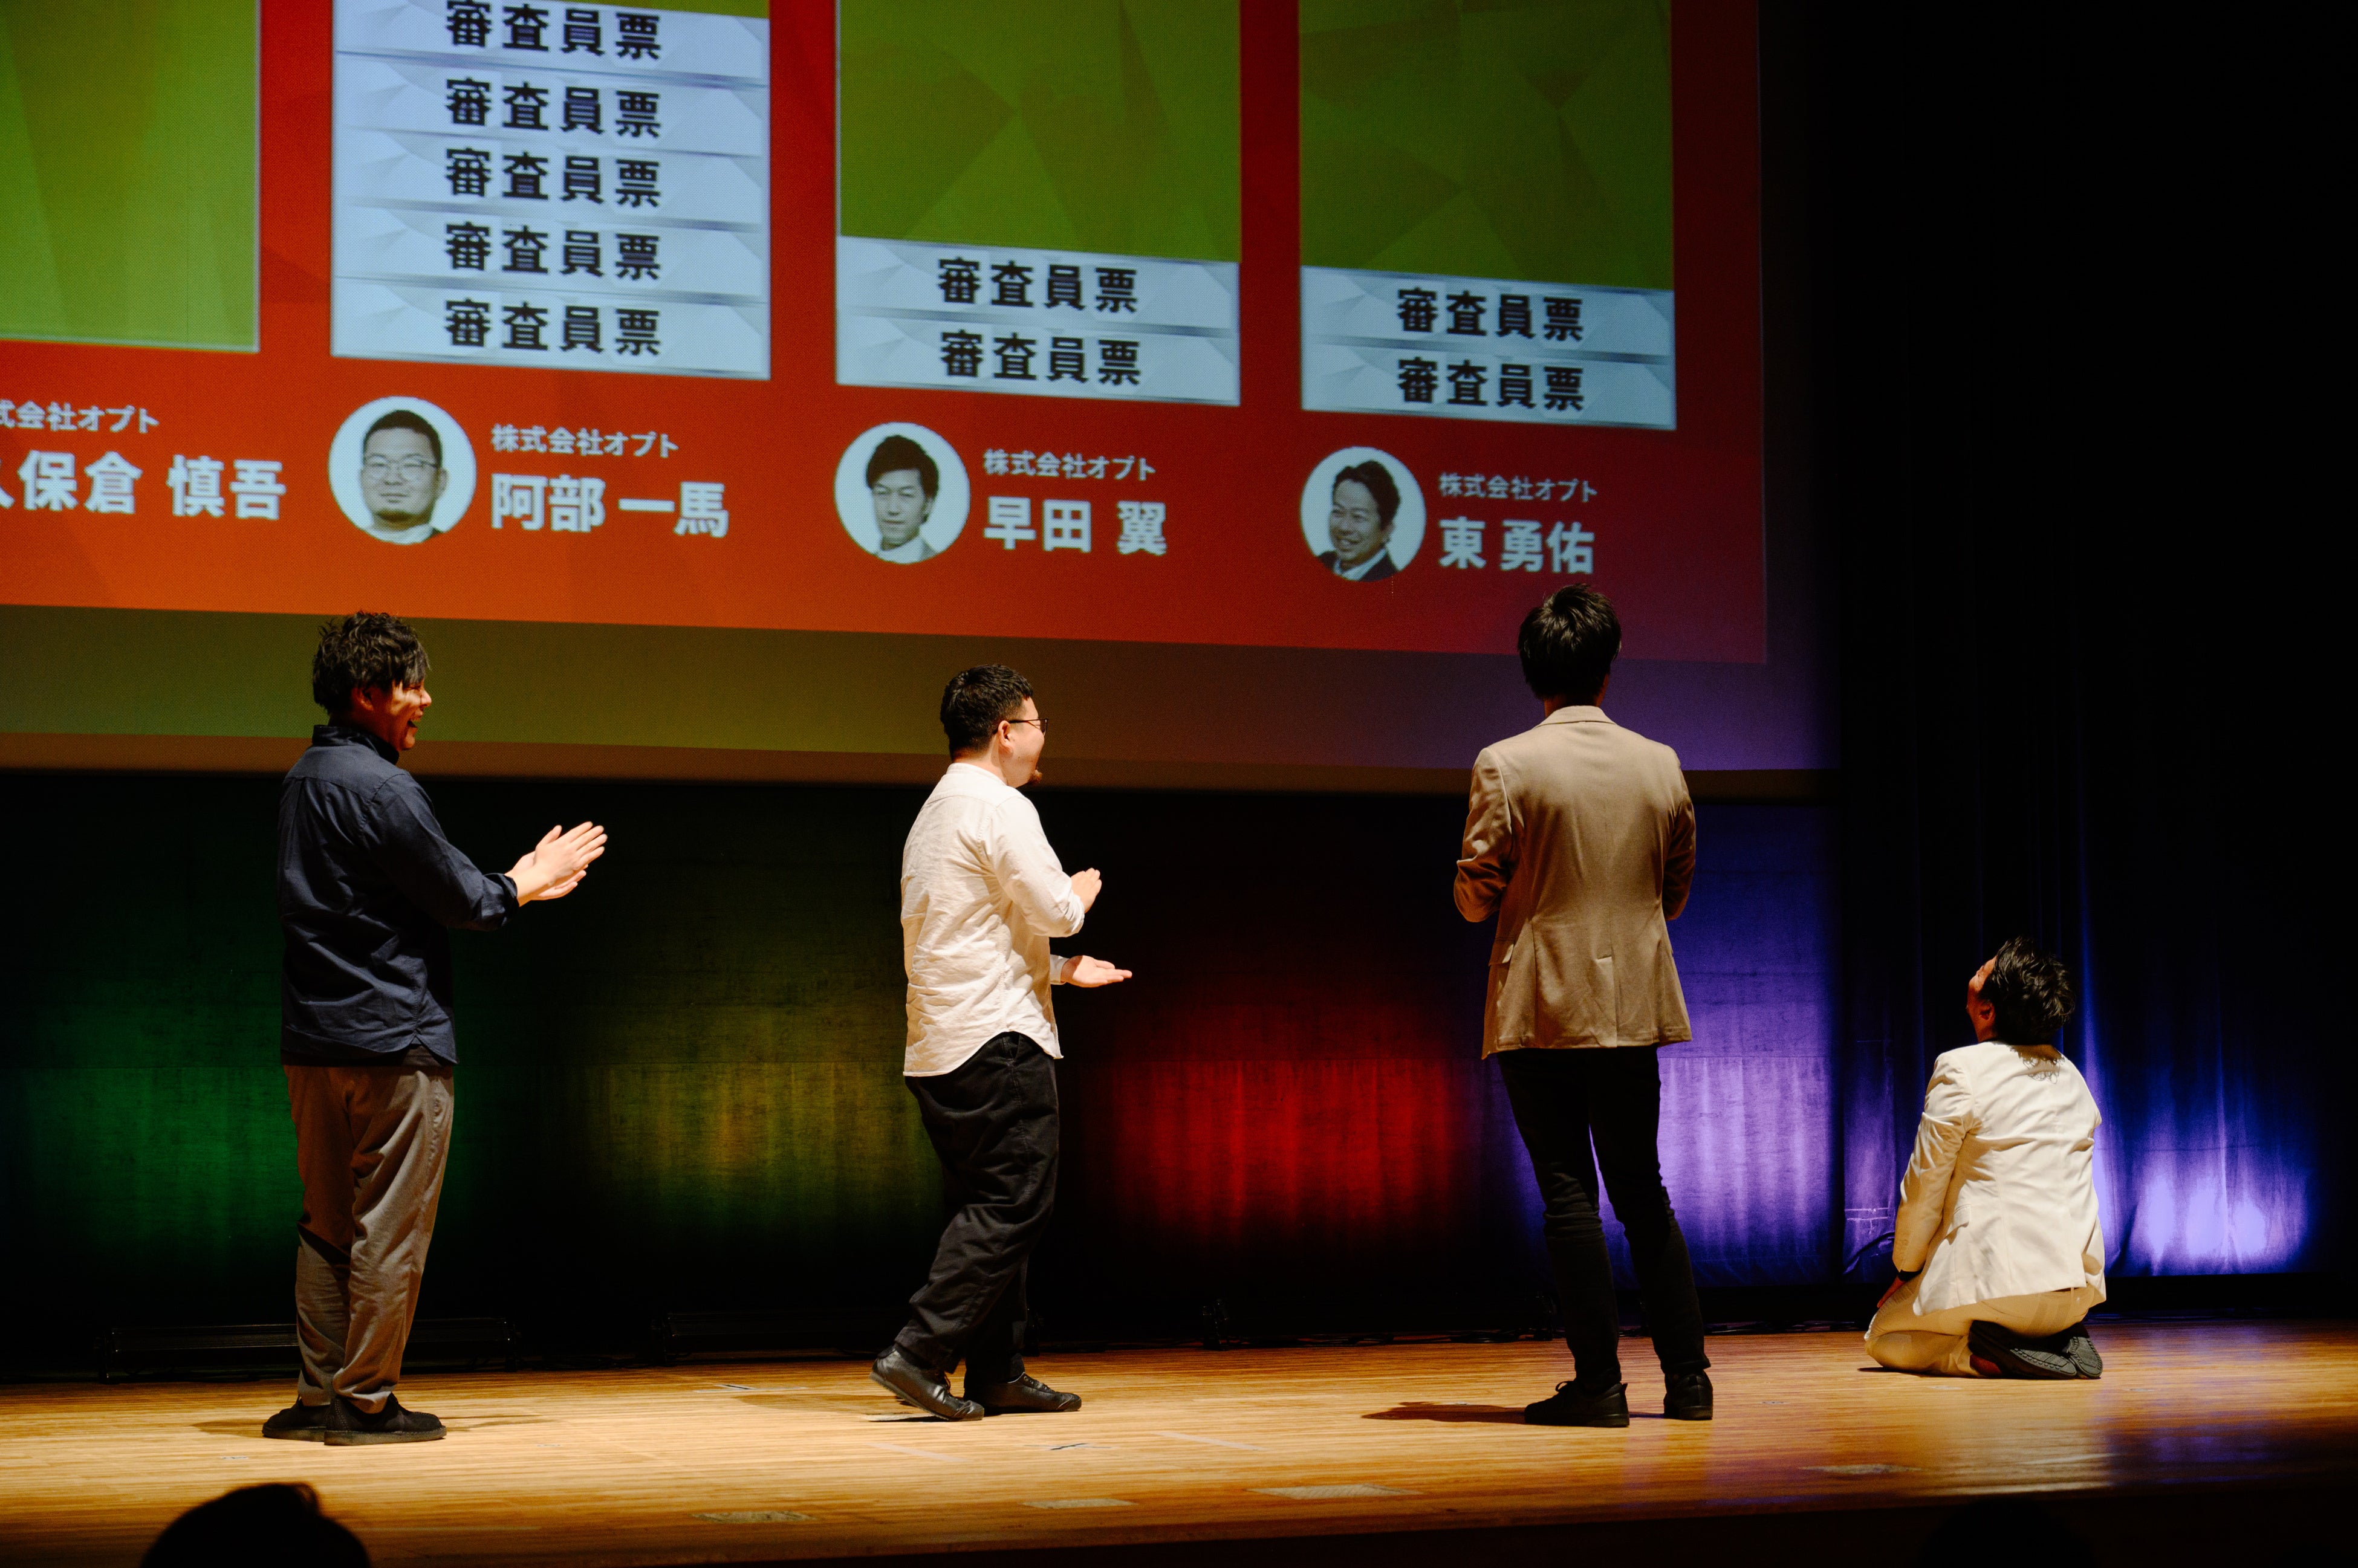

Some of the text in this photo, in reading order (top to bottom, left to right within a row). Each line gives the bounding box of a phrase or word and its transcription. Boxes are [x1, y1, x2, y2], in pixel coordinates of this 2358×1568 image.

[446, 0, 661, 60] 審査員票
[446, 78, 661, 138] 審査員票
[446, 148, 661, 207] 審査員票
[446, 222, 661, 280] 審査員票
[938, 257, 1137, 313] 審査員票
[446, 299, 661, 356] 審査員票
[1398, 287, 1583, 342] 審査員票
[940, 330, 1141, 385] 審査員票
[1398, 357, 1583, 411] 審査員票
[490, 423, 680, 458] 株式会社オプト
[983, 448, 1156, 481] 株式会社オプト
[0, 450, 287, 520] 保倉 慎吾
[490, 473, 729, 538] 阿部 一馬
[1438, 471, 1598, 503] 株式会社オプト
[983, 496, 1168, 556] 早田 翼
[1438, 516, 1595, 575] 東 勇佑
